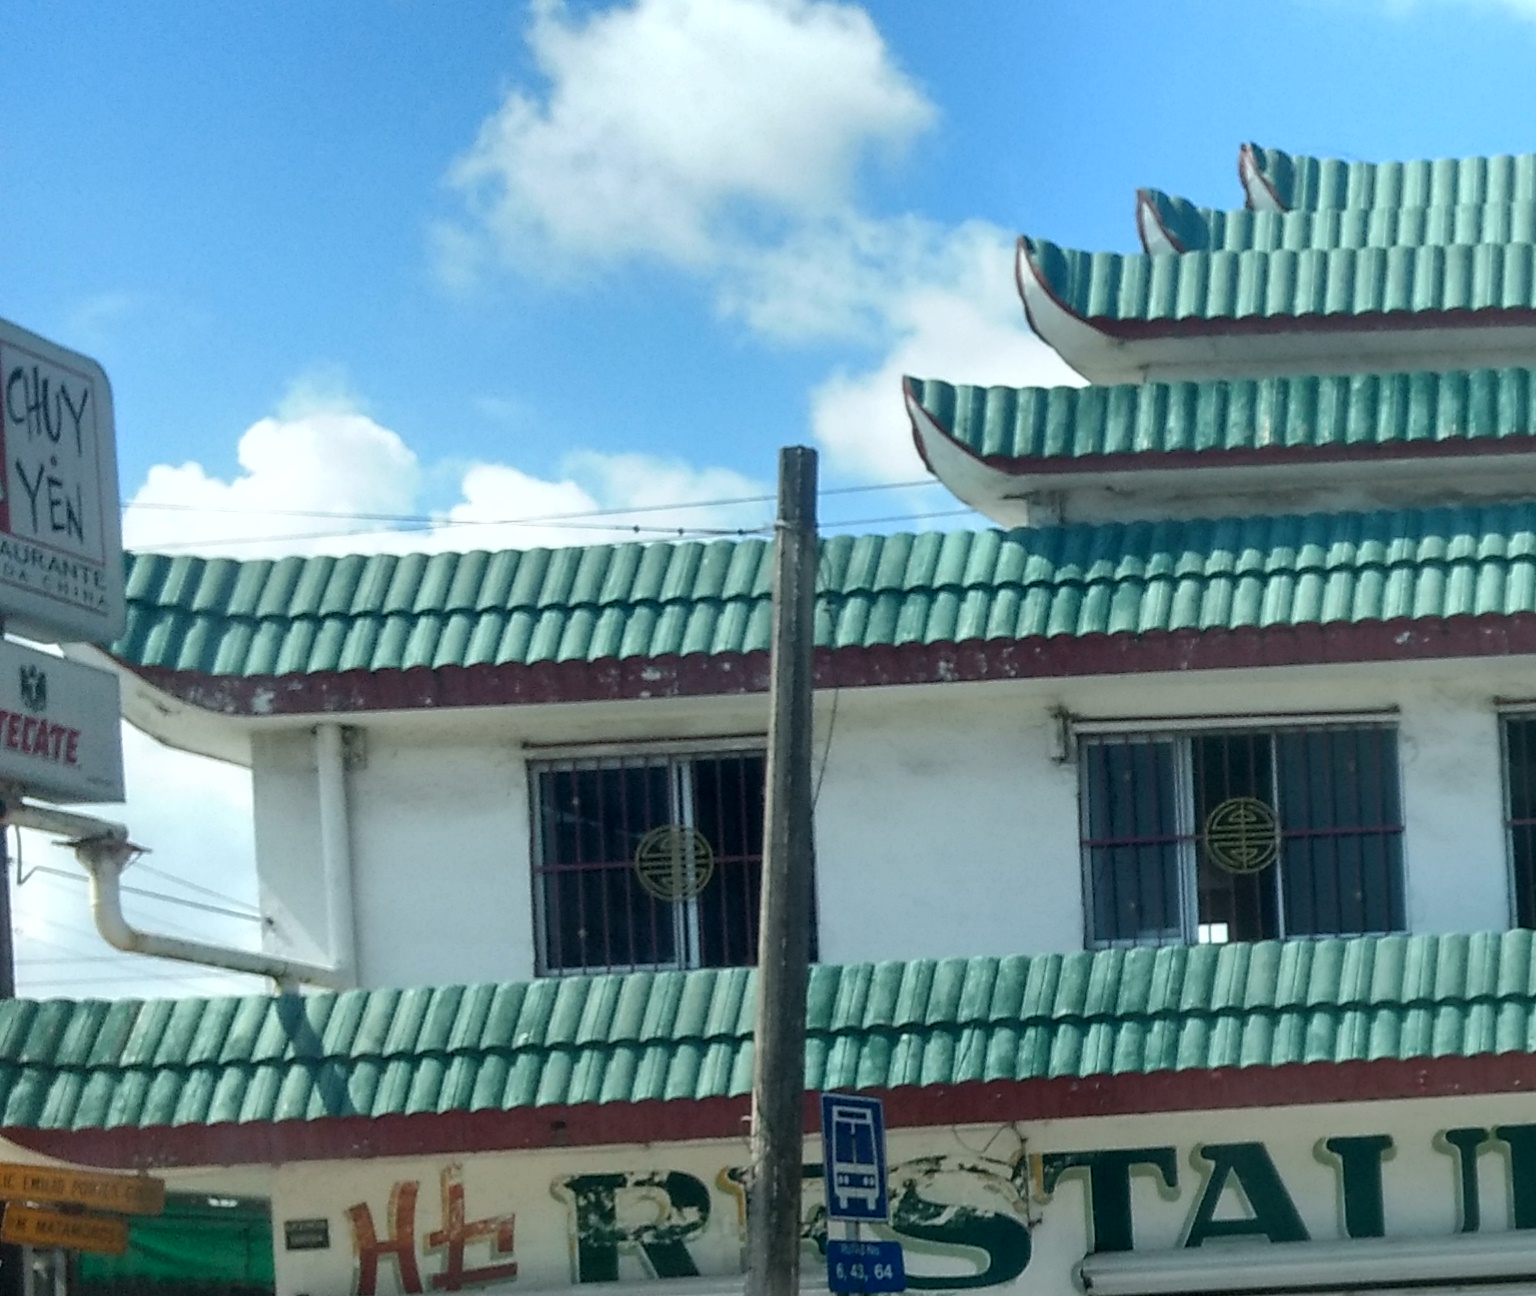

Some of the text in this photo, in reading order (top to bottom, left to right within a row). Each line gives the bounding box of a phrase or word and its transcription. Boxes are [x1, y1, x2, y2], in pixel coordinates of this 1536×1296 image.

[6, 366, 88, 457] CHUY
[0, 540, 107, 592] AURANTE
[874, 1263, 894, 1281] 64
